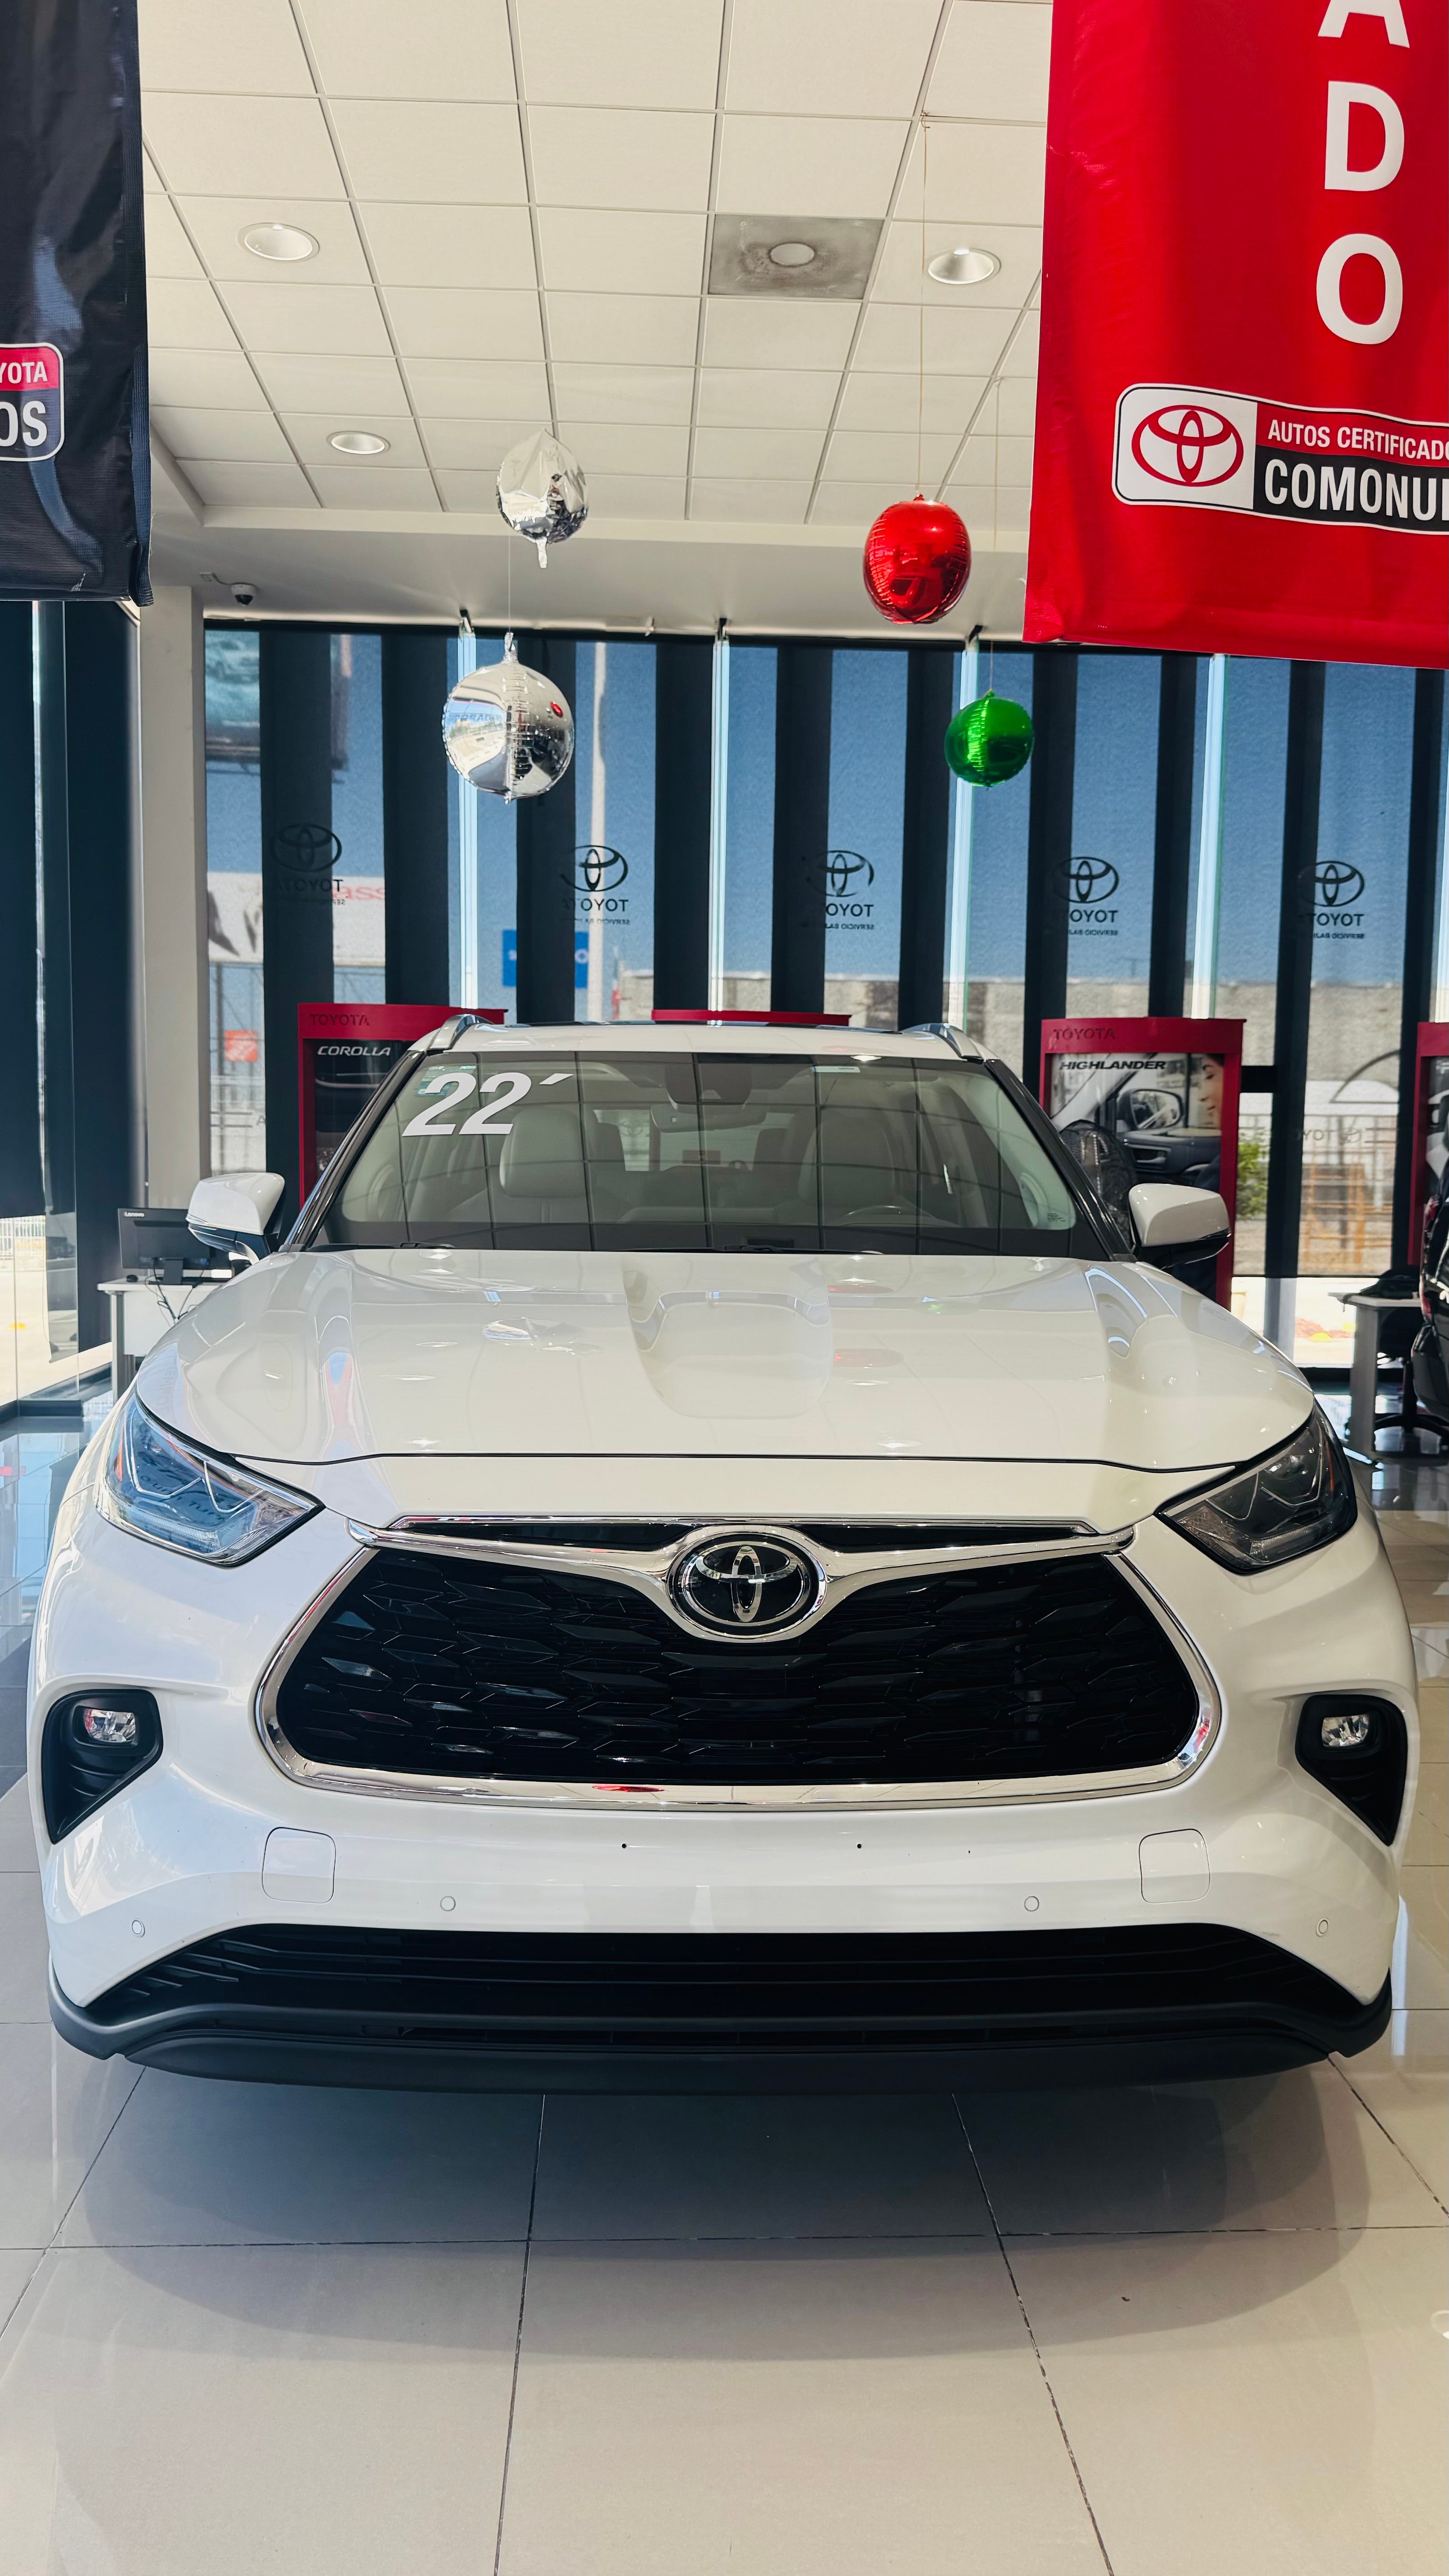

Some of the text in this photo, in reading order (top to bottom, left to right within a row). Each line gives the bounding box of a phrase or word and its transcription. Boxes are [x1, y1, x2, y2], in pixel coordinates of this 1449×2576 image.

[0, 400, 47, 446] OS
[1268, 419, 1449, 461] AUTOS CERTIFICAD
[310, 1014, 369, 1026] TOYOTA
[1053, 1028, 1116, 1040] TOYOTA
[317, 1046, 391, 1056] COROLLA
[1059, 1061, 1166, 1070] HIGHLANDER
